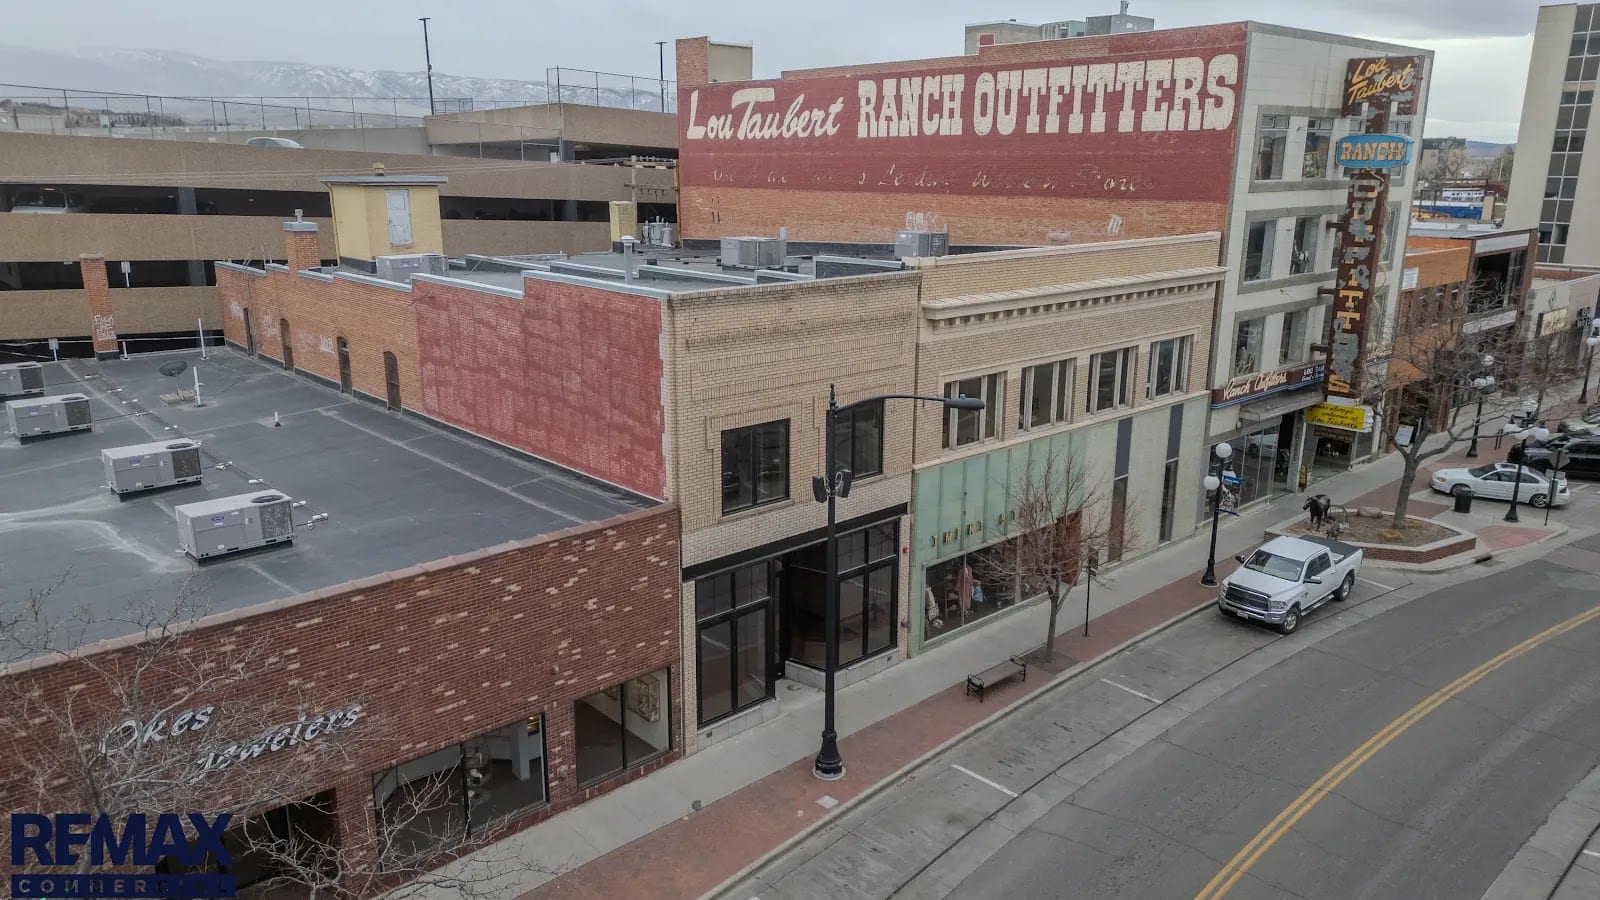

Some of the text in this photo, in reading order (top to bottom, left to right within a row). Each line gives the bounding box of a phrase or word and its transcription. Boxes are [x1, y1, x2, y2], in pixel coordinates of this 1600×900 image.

[1348, 63, 1415, 105] Taubert
[1352, 58, 1388, 84] Lou
[687, 54, 1238, 141] Lou Taubert RANCH OUTFITTERS
[1341, 142, 1403, 160] RANCH
[1223, 379, 1251, 400] Ranch
[99, 706, 214, 754] Okes
